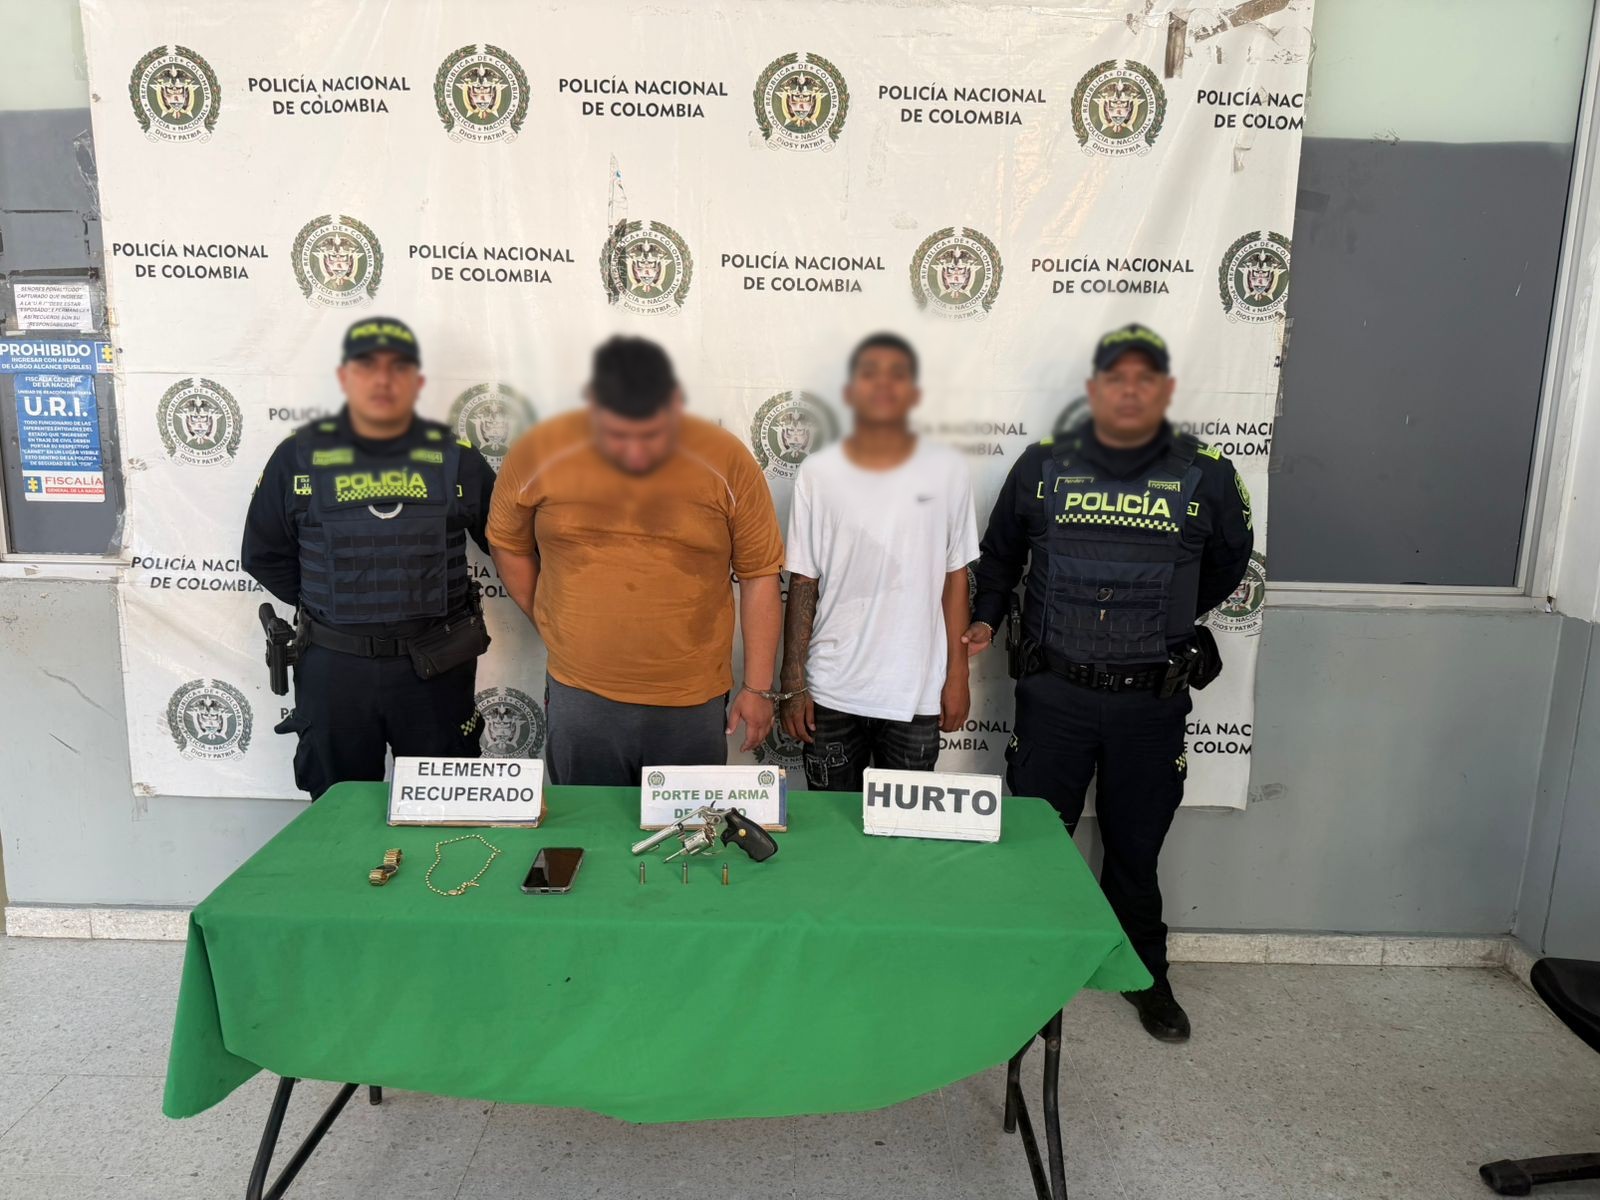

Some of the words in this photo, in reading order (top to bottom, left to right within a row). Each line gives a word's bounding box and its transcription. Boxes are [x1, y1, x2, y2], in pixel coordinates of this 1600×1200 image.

[249, 75, 317, 92] POLICÍA
[323, 76, 410, 91] NACIONAL
[560, 75, 628, 93] POLICÍA
[635, 81, 727, 96] NACIONAL
[879, 83, 947, 100] POLICÍA
[955, 88, 1046, 103] NACIONAL
[1197, 88, 1262, 106] POLICÍA
[273, 101, 294, 114] DE
[301, 99, 388, 114] COLOMBIA
[583, 102, 604, 115] DE
[611, 102, 704, 117] COLOMBIA
[902, 109, 922, 122] DE
[929, 109, 1022, 124] COLOMBIA
[1214, 114, 1236, 128] DE
[113, 240, 177, 256] POLICÍA
[184, 245, 268, 258] NACIONAL
[410, 243, 477, 259] POLICÍA
[484, 247, 574, 262] NACIONAL
[722, 251, 788, 268] POLICÍA
[796, 256, 885, 270] NACIONAL
[1032, 254, 1100, 272] POLICÍA
[1107, 258, 1193, 272] NACIONAL
[136, 265, 156, 277] DE
[162, 265, 248, 278] COLOMBIA
[432, 267, 453, 280] DE
[460, 268, 551, 283] COLOMBIA
[744, 277, 764, 290] DE
[771, 278, 861, 292] COLOMBIA
[1053, 281, 1074, 293] DE
[1081, 280, 1169, 293] COLOMBIA
[0, 344, 90, 356] PROHIBIDO
[24, 396, 88, 416] U.R.I.
[45, 475, 104, 486] FISCALÍA
[1064, 490, 1170, 518] POLICÍA
[131, 554, 196, 571] POLICÍA
[150, 577, 170, 589] DE
[176, 578, 264, 593] COLOMBIA
[418, 762, 521, 777] ELEMENTO
[401, 786, 534, 802] RECUPERADO
[652, 790, 700, 800] PORTE
[704, 790, 723, 800] DE
[728, 790, 769, 800] ARMA
[867, 782, 997, 816] HURTO
